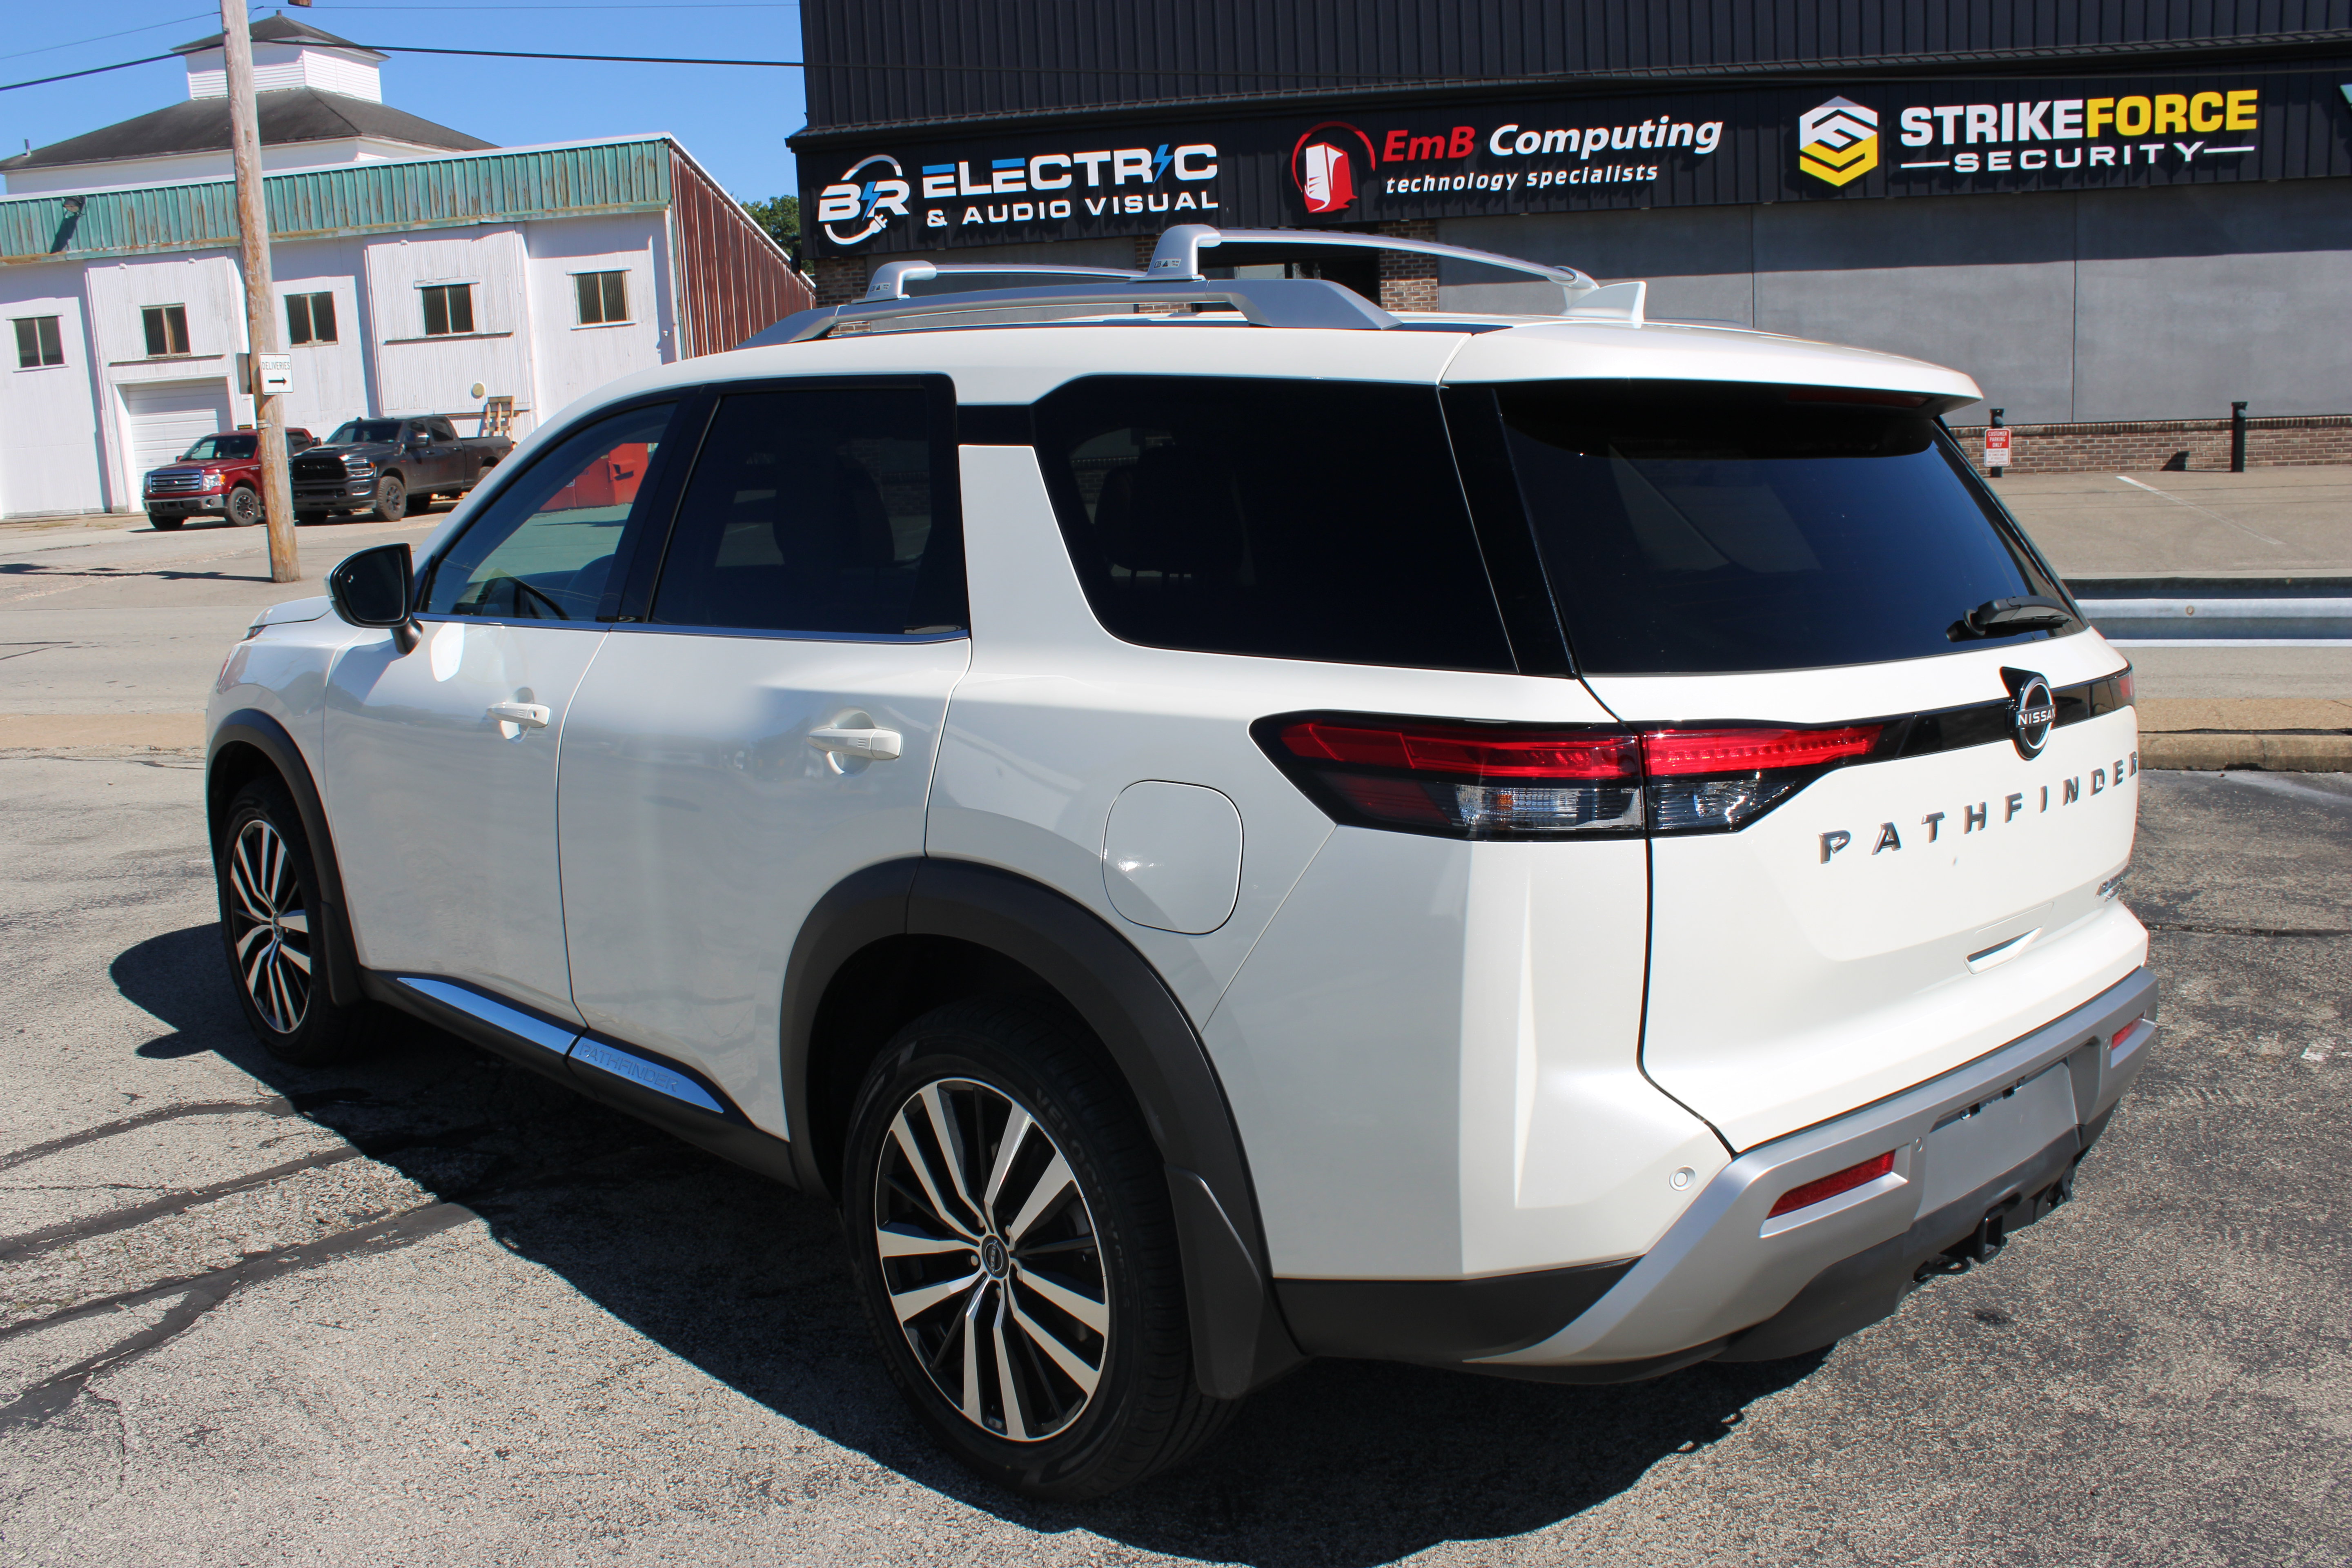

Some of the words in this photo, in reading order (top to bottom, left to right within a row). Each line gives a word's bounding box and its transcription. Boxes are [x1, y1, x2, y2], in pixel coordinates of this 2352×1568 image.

[1383, 126, 1476, 162] EmB
[1489, 115, 1724, 160] Computing
[1954, 141, 2204, 173] SECURITY
[922, 143, 1218, 199] ELECTRIC
[1386, 172, 1519, 194] technology
[1526, 164, 1658, 189] specialists
[927, 209, 948, 227] &
[962, 199, 1071, 225] AUDIO
[1084, 191, 1218, 216] VISUAL
[262, 362, 290, 370] DELIVERIES
[2018, 708, 2055, 726] NISSAN
[1818, 751, 2137, 864] PATHFINDER
[578, 1043, 679, 1092] PATHFINDER
[1034, 1087, 1119, 1239] VELOCITY
[990, 1238, 998, 1275] NISSAN
